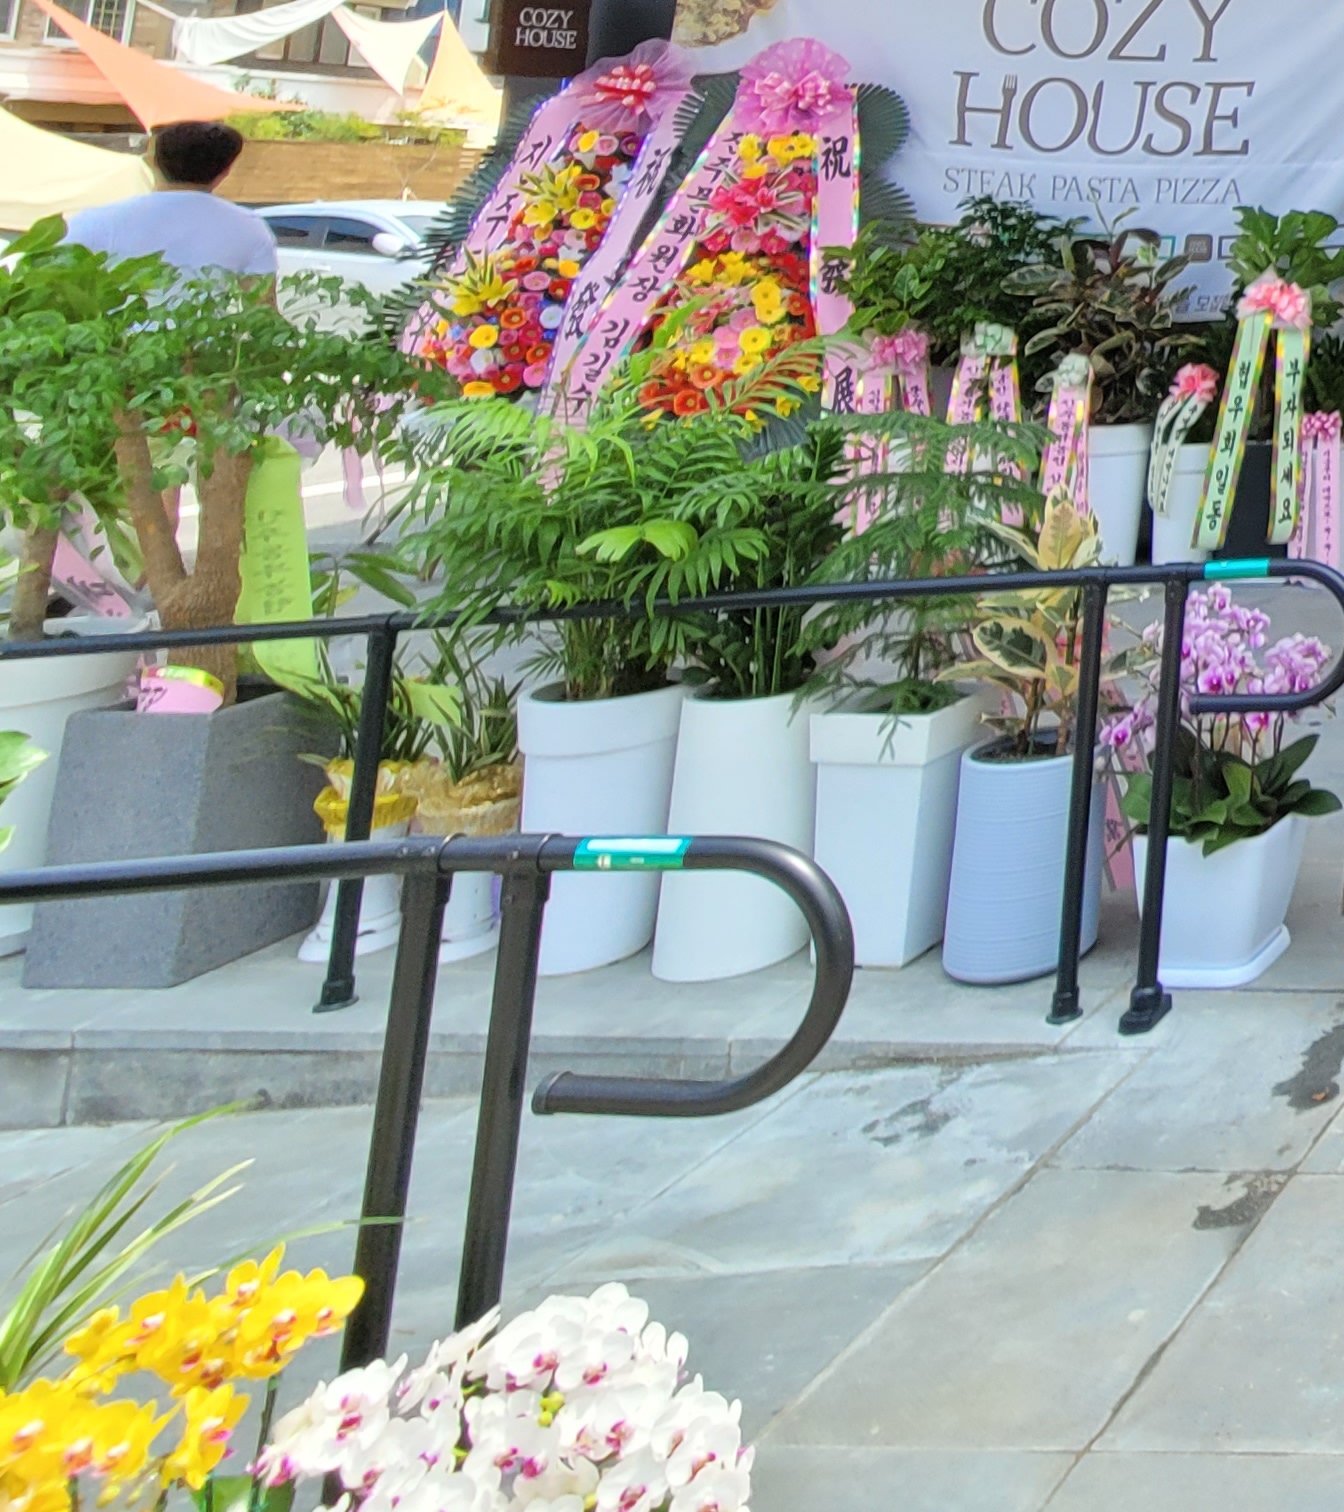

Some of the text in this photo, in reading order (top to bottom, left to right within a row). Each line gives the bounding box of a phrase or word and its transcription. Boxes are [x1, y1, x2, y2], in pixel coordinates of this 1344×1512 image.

[519, 7, 574, 29] COZY
[515, 27, 577, 50] HOUSE
[948, 70, 1256, 158] HOUSE
[943, 168, 1242, 206] STEAK PASTA PIZZA
[1278, 358, 1301, 524] 부자되세요
